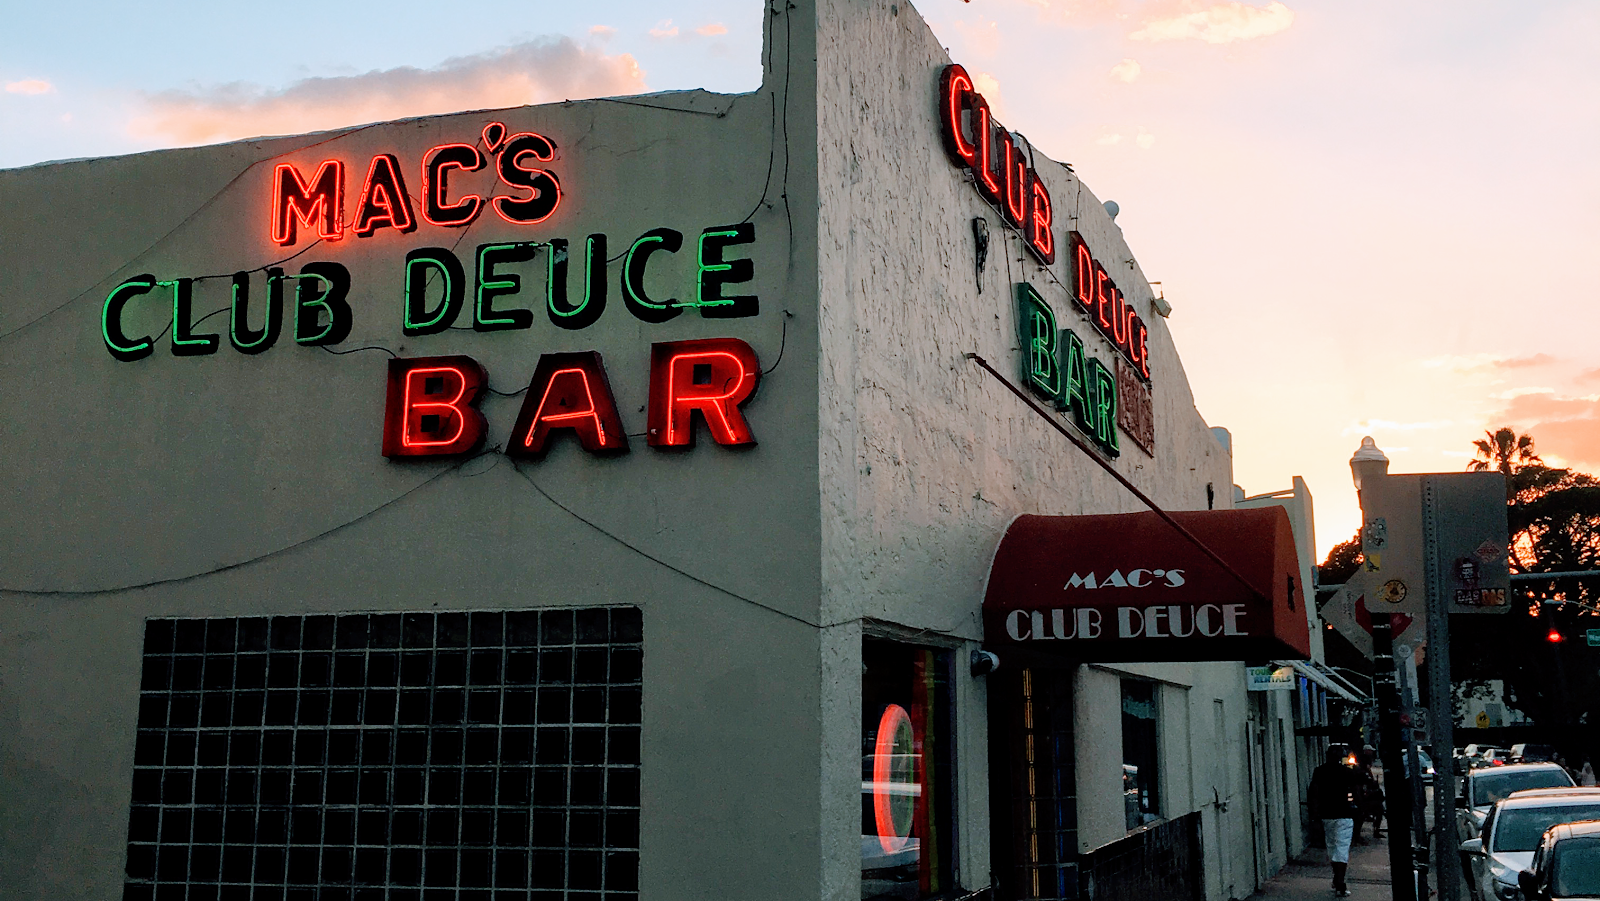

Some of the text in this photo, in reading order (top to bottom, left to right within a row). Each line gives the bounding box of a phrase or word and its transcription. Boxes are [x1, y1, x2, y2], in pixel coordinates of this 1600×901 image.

[270, 122, 562, 245] MAC'S
[940, 64, 1150, 386] CLUB DEUCE
[103, 223, 759, 361] CLUB DEUCE
[383, 339, 762, 460] BAR
[1018, 283, 1120, 457] BAR
[1006, 604, 1249, 641] CLUB DEUCE
[1064, 569, 1186, 590] MAC'S
